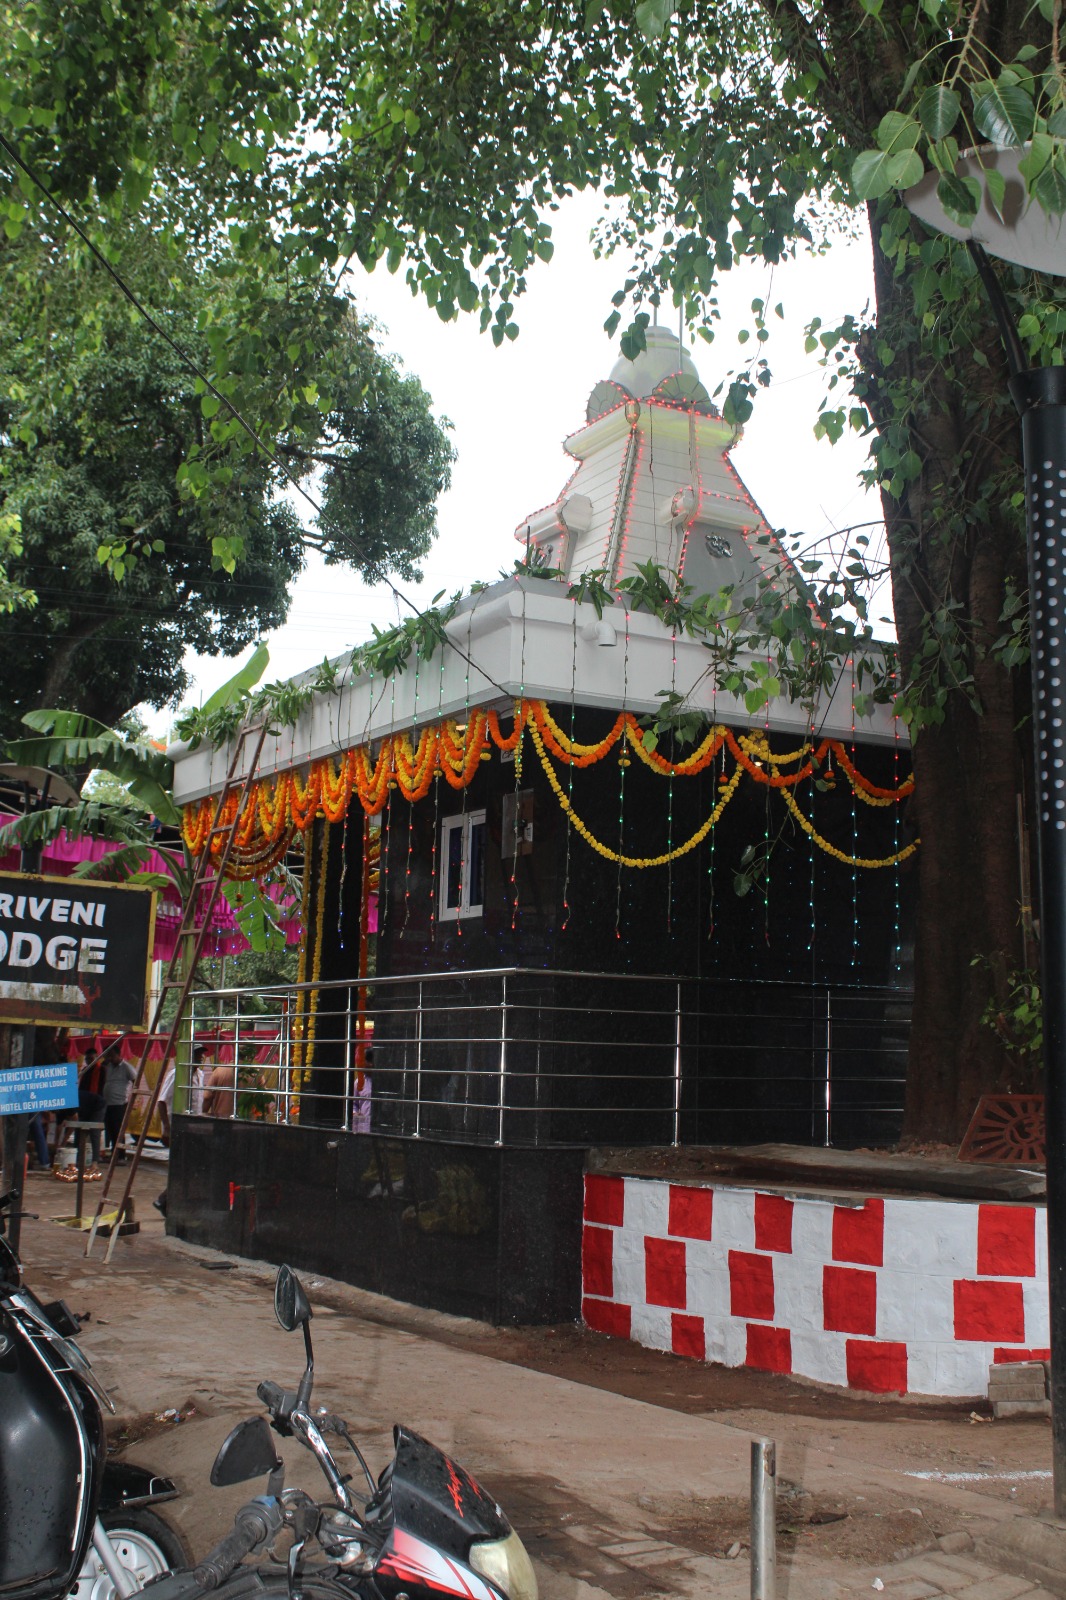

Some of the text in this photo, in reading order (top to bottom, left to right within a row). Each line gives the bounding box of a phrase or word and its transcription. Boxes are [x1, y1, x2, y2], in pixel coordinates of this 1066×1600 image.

[0, 892, 106, 928] RIVENI
[0, 929, 108, 974] DGE
[34, 1067, 68, 1079] PARKING
[14, 1084, 26, 1092] FOR
[26, 1082, 49, 1090] TRIVENI
[49, 1080, 67, 1088] LODGE
[30, 1091, 37, 1099] &
[0, 1098, 66, 1112] HOTEL DEVI PRASAD
